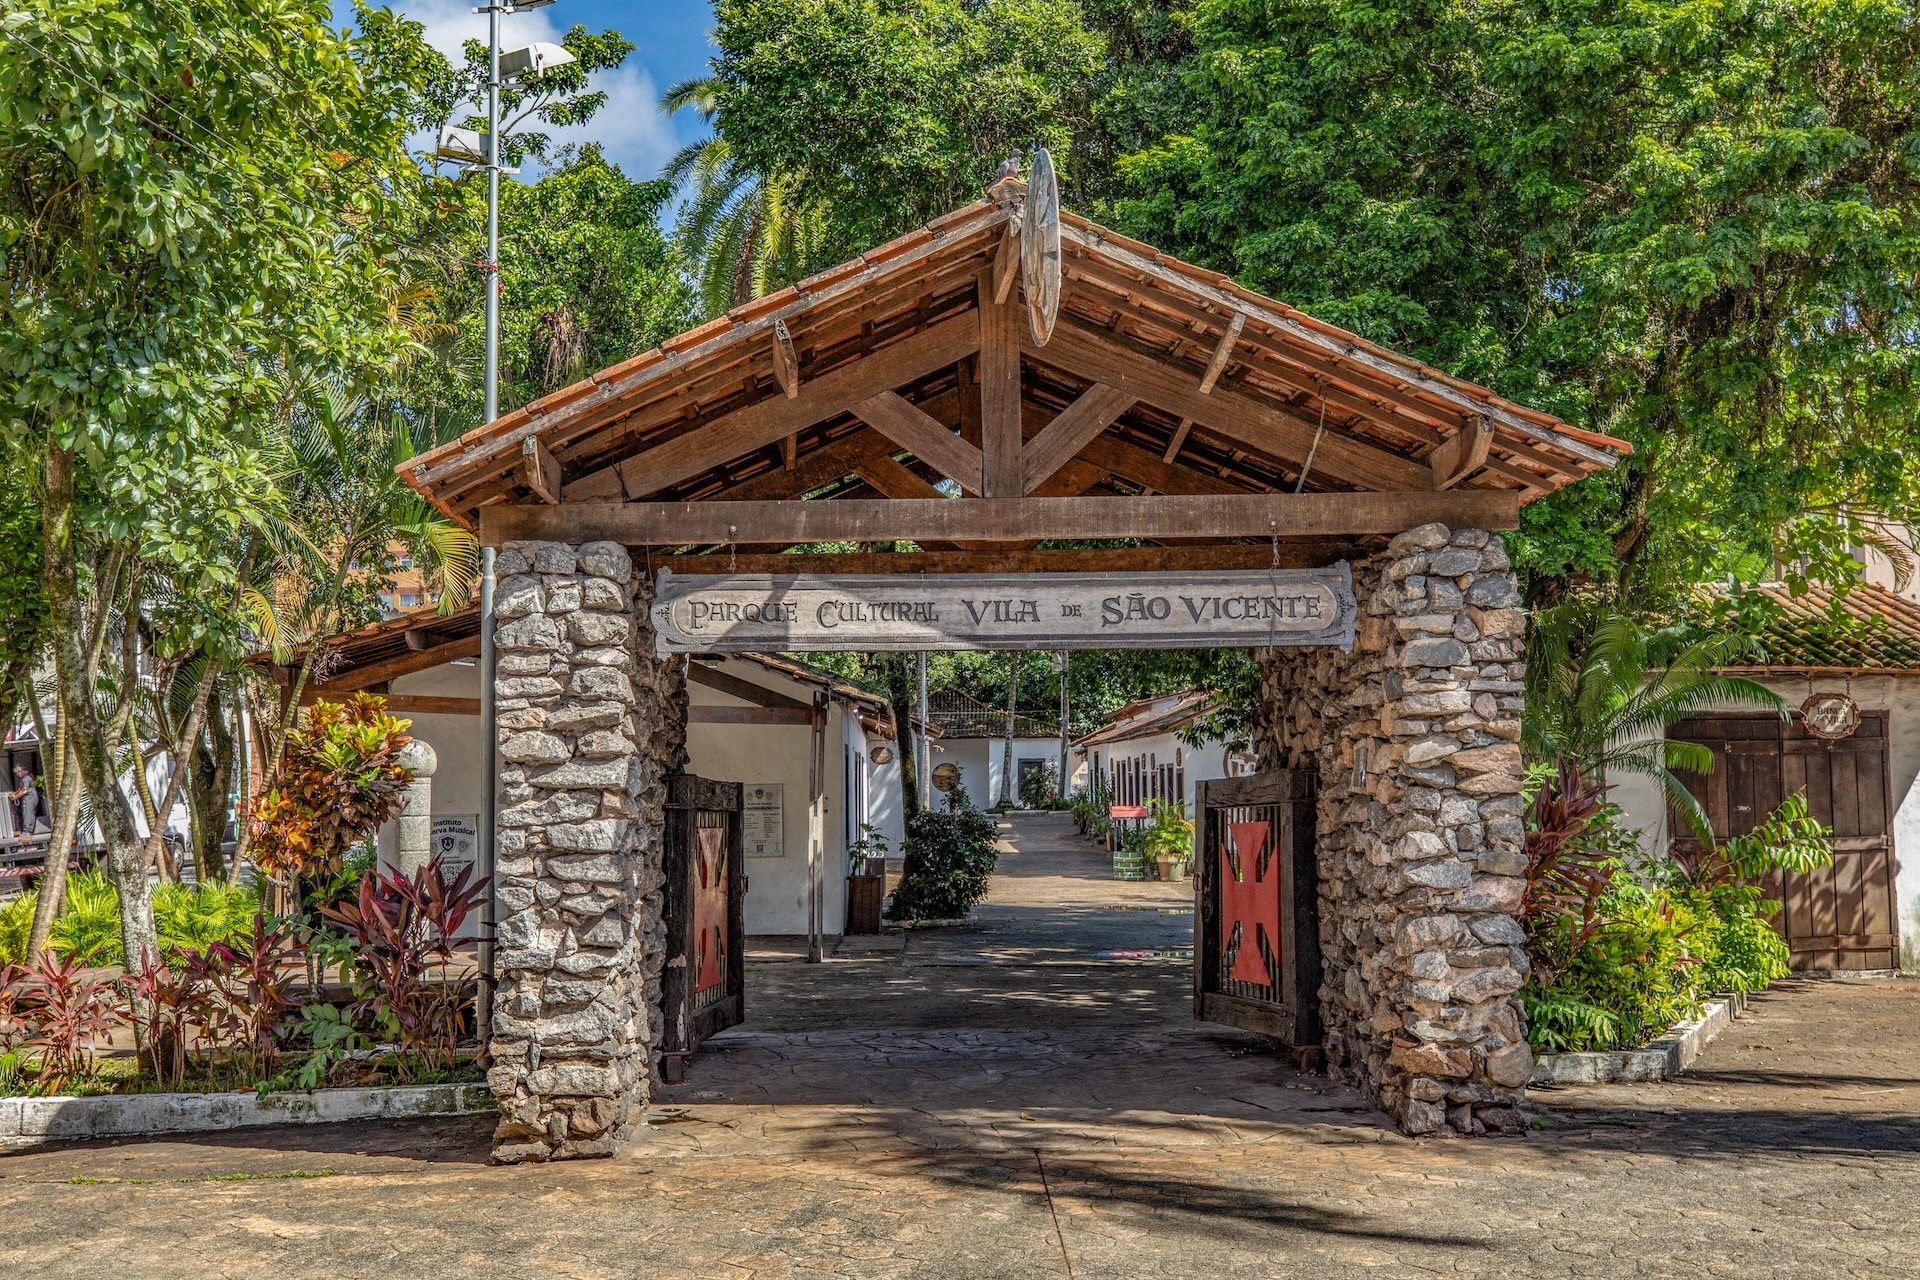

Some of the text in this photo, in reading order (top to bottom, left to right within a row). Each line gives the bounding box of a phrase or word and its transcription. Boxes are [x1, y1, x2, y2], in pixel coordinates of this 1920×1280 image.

[688, 593, 1322, 630] PARQUE CULTURAL VILA DE SÃO VICENTE
[448, 826, 476, 836] Musical
